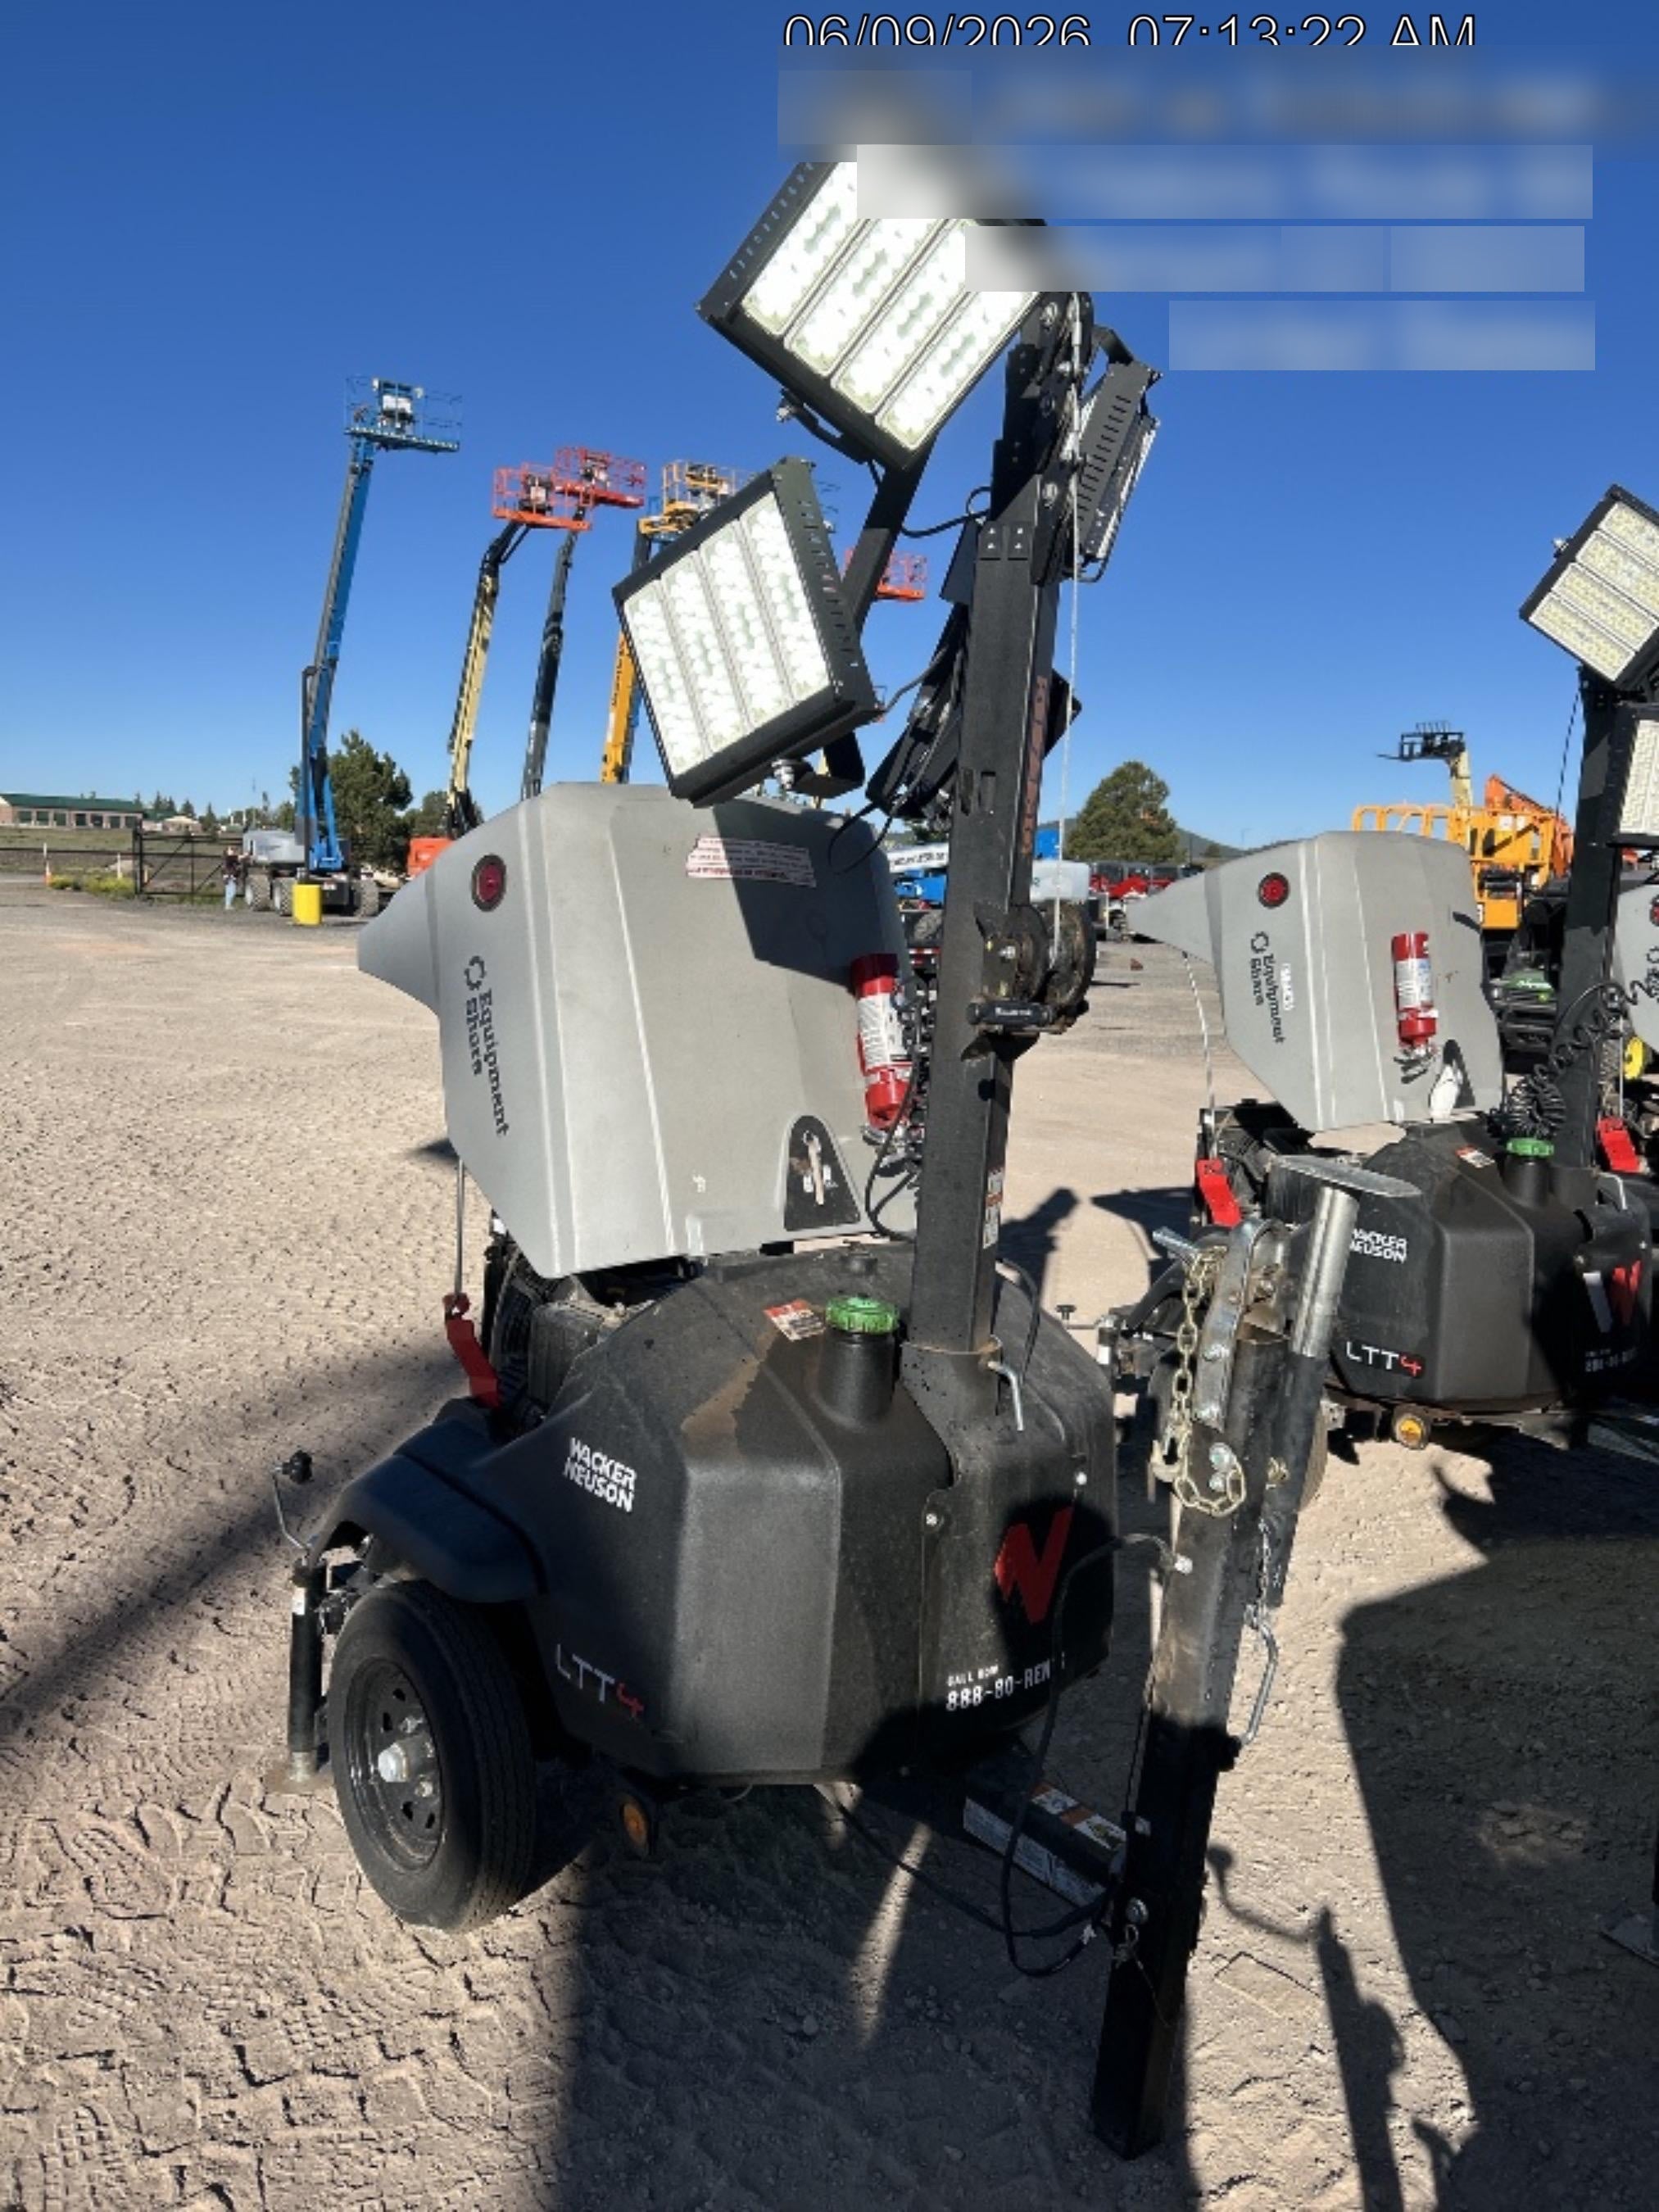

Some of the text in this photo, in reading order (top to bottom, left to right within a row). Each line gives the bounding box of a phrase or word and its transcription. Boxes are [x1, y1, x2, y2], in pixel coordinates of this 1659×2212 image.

[478, 988, 510, 1136] Equipment
[1346, 1341, 1422, 1377] LTT4
[563, 1457, 634, 1512] NEUSON
[569, 1437, 637, 1491] WACKER
[555, 1643, 645, 1719] LTT4
